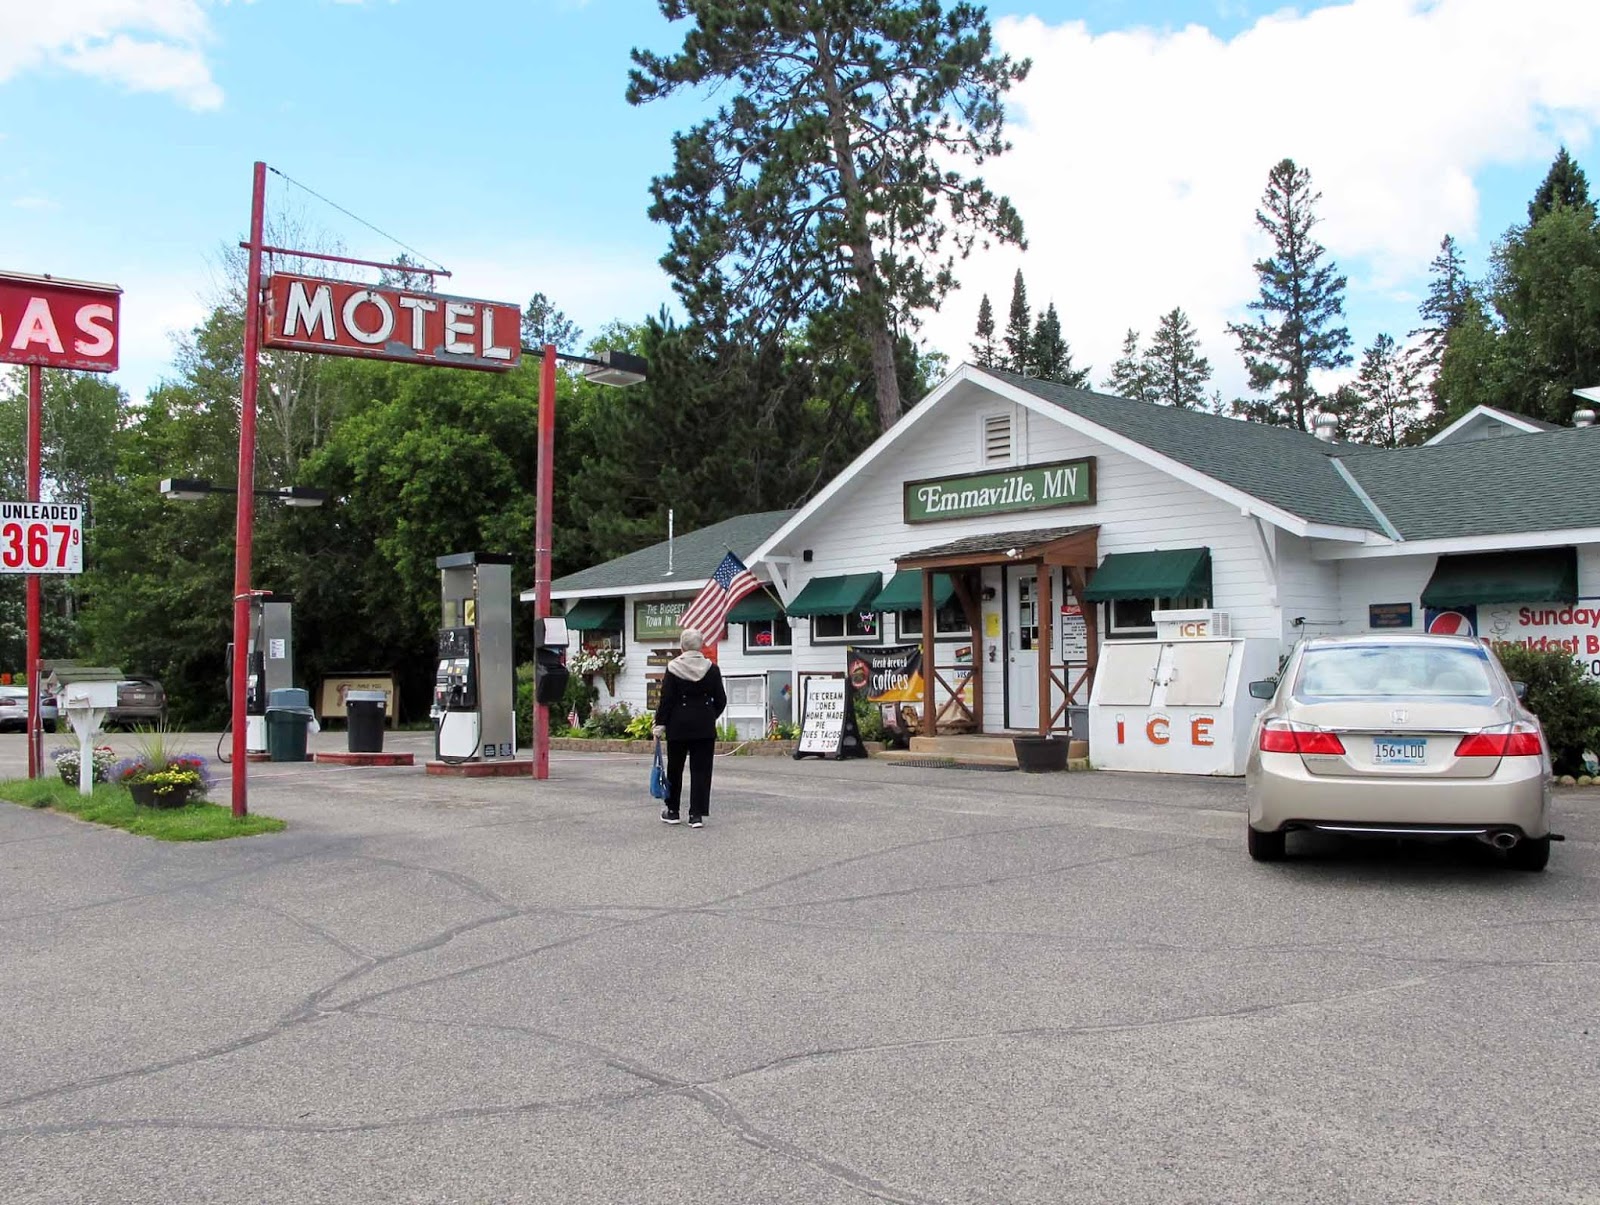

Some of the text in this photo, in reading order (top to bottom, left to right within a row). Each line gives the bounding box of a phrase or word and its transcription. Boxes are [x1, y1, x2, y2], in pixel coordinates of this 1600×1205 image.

[0, 296, 114, 357] AS
[282, 281, 513, 361] MOTEL
[917, 467, 1078, 513] Emmaville, MN
[2, 504, 78, 521] UNLEADED
[645, 615, 662, 628] TOWN
[1518, 605, 1600, 628] Sunday
[449, 631, 455, 642] 2
[1179, 622, 1207, 637] ICE
[872, 657, 886, 669] fresh
[873, 669, 909, 691] coffees
[821, 691, 844, 701] CREAM
[826, 711, 845, 720] MADE
[1115, 713, 1215, 747] ICE
[1375, 744, 1396, 758] 156
